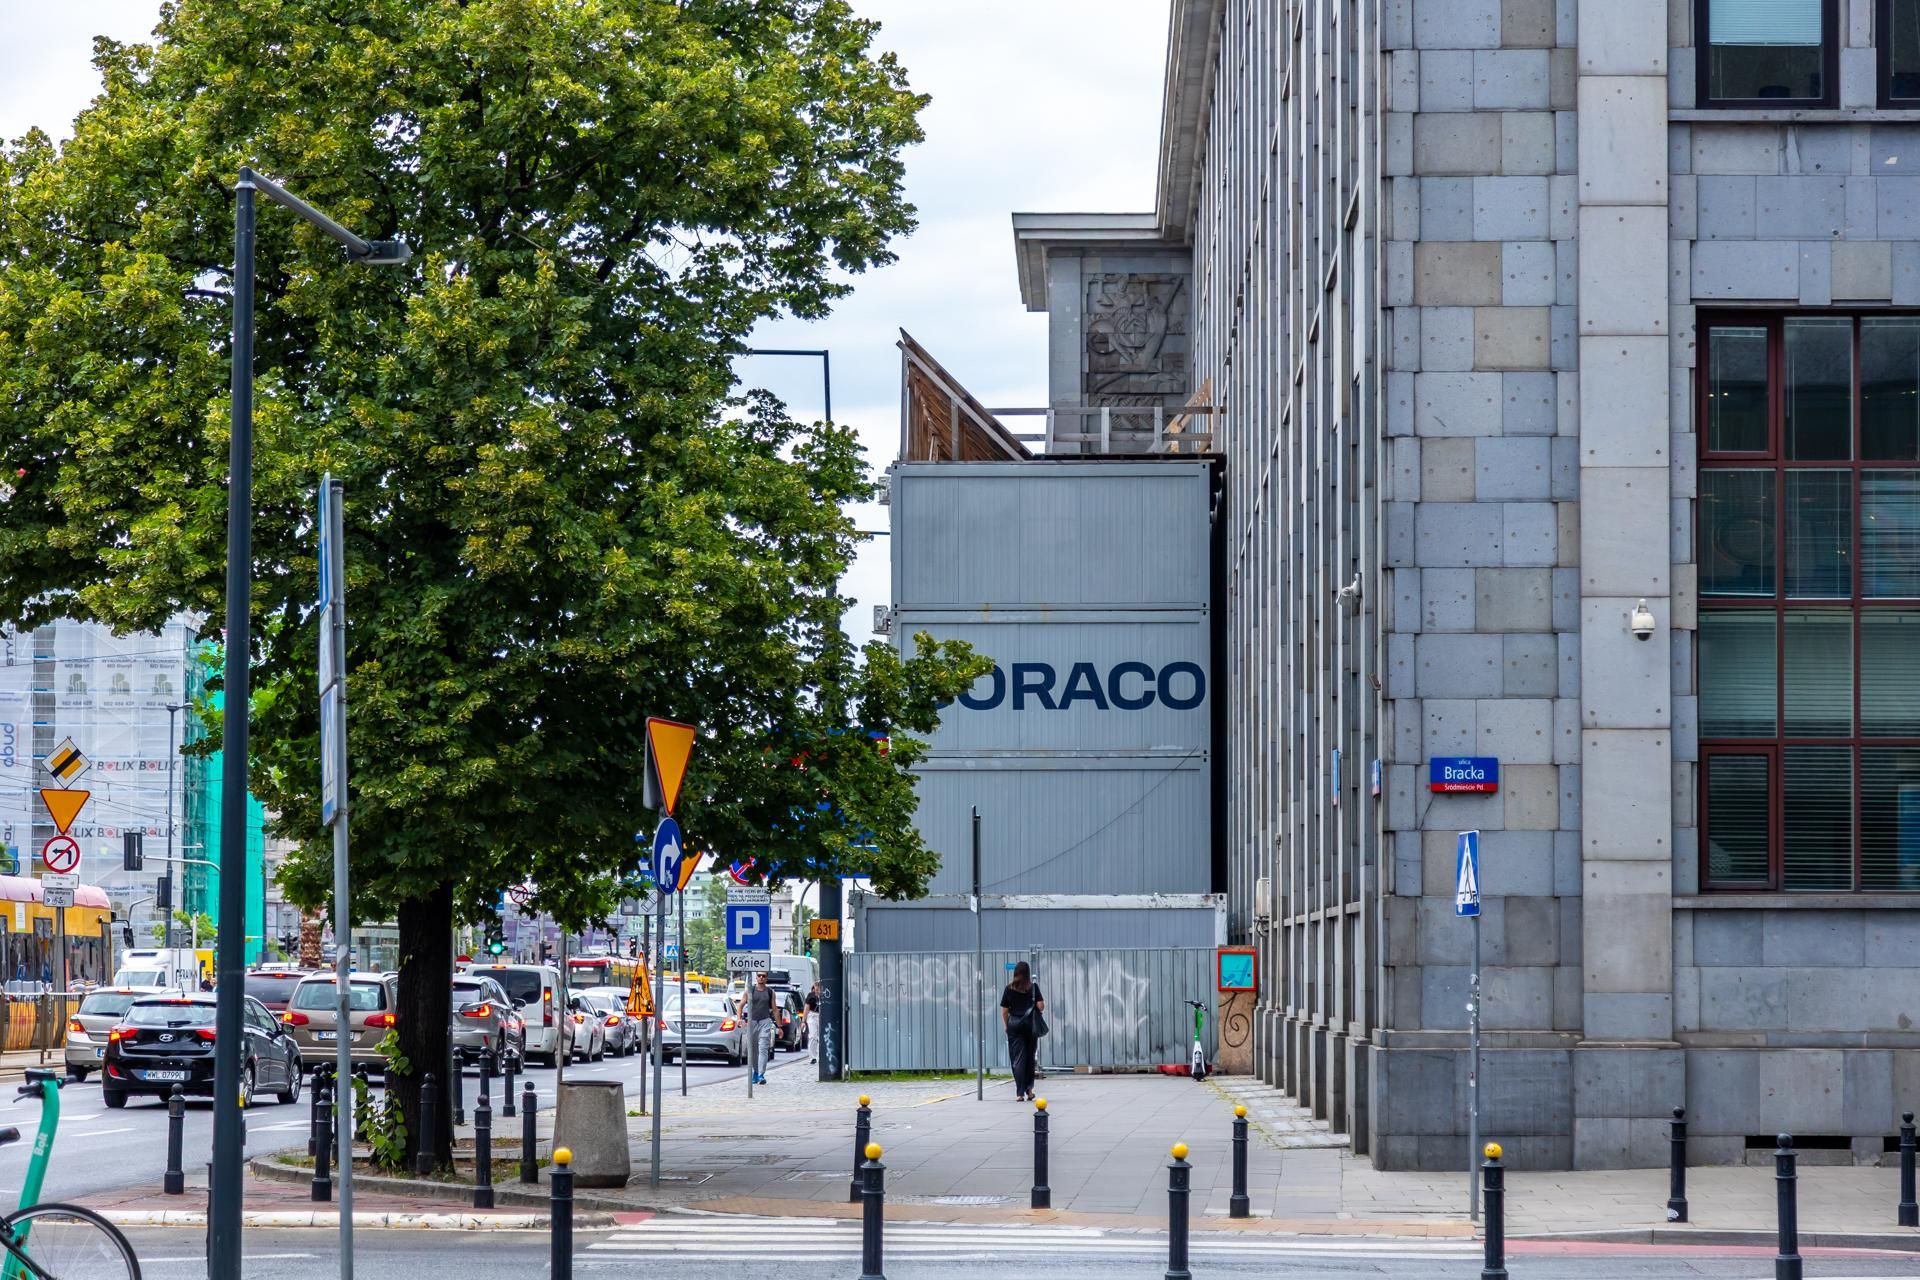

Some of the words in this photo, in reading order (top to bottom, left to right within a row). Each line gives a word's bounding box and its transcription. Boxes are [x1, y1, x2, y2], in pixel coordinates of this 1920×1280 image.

[935, 661, 1207, 711] ORACO
[1444, 766, 1485, 779] Bracka
[736, 910, 760, 945] P
[816, 923, 832, 935] 631
[730, 956, 765, 968] Koniec
